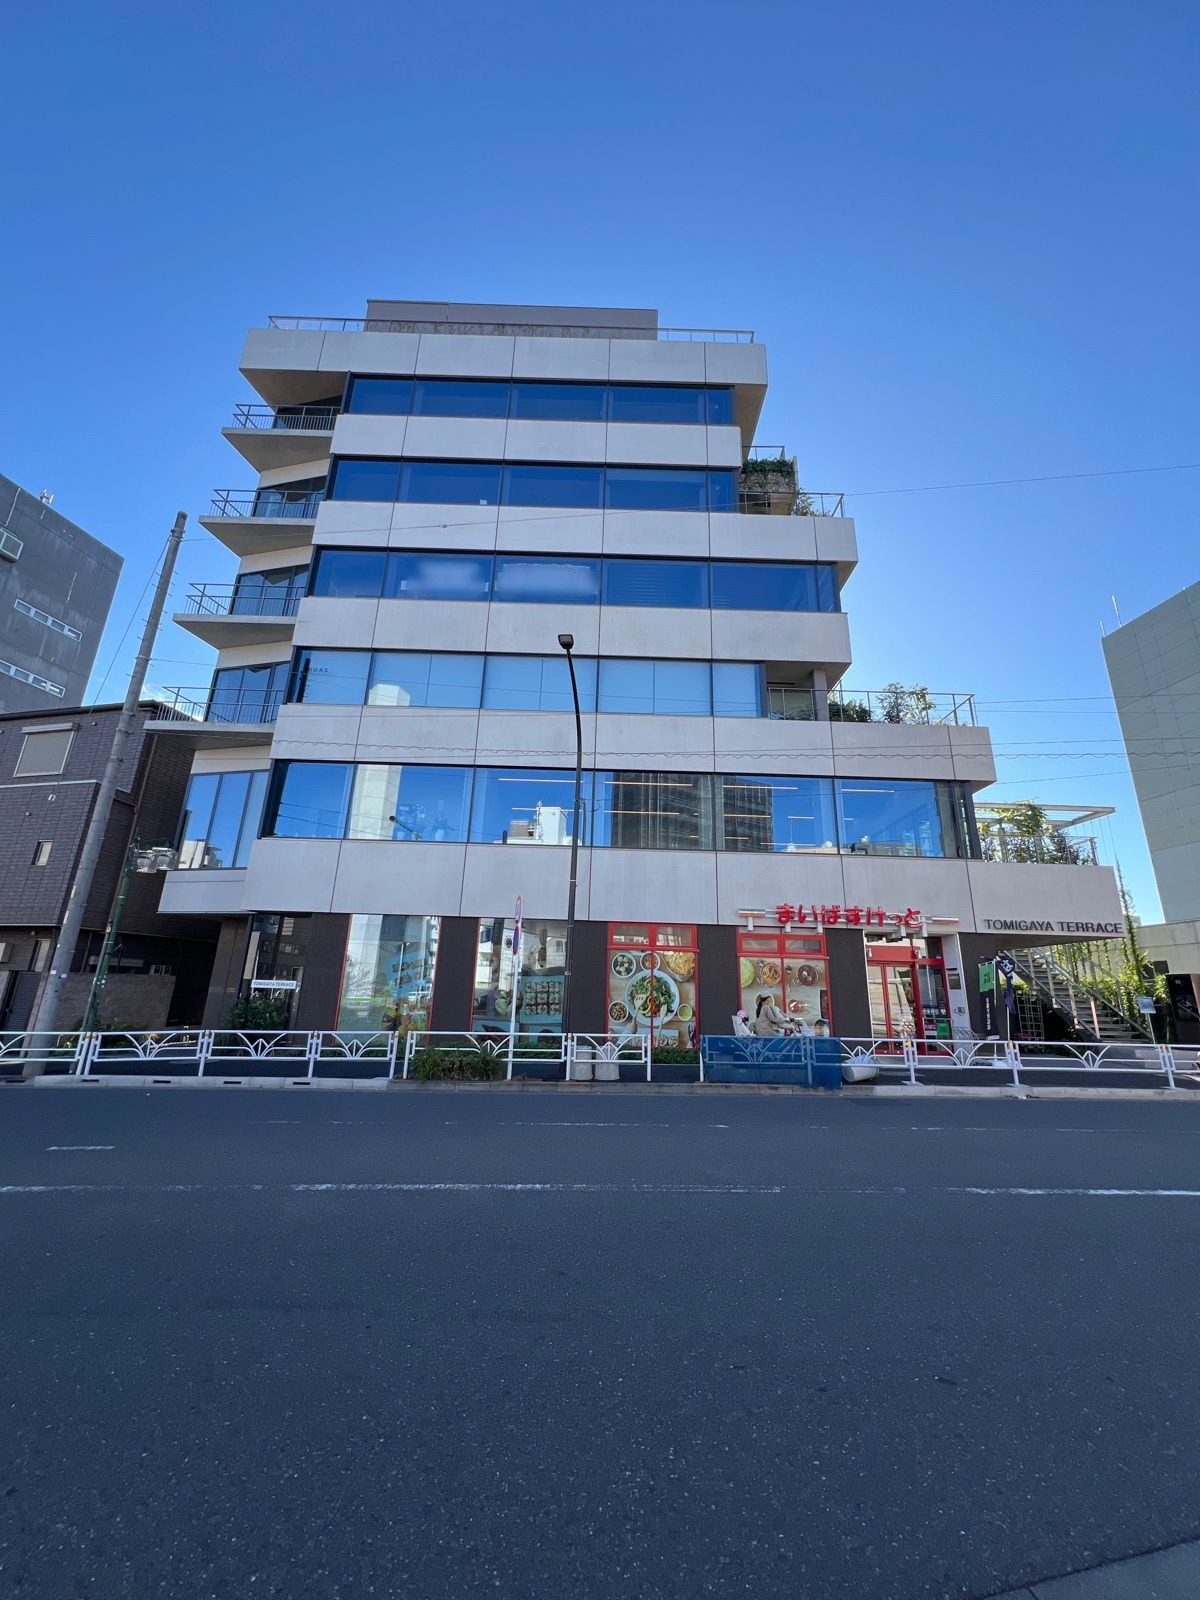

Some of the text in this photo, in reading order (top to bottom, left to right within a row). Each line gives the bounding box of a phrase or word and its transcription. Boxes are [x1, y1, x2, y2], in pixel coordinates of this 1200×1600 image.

[776, 903, 923, 928] まいばすけっと
[984, 919, 1124, 934] TOMIGAYA TERRACE
